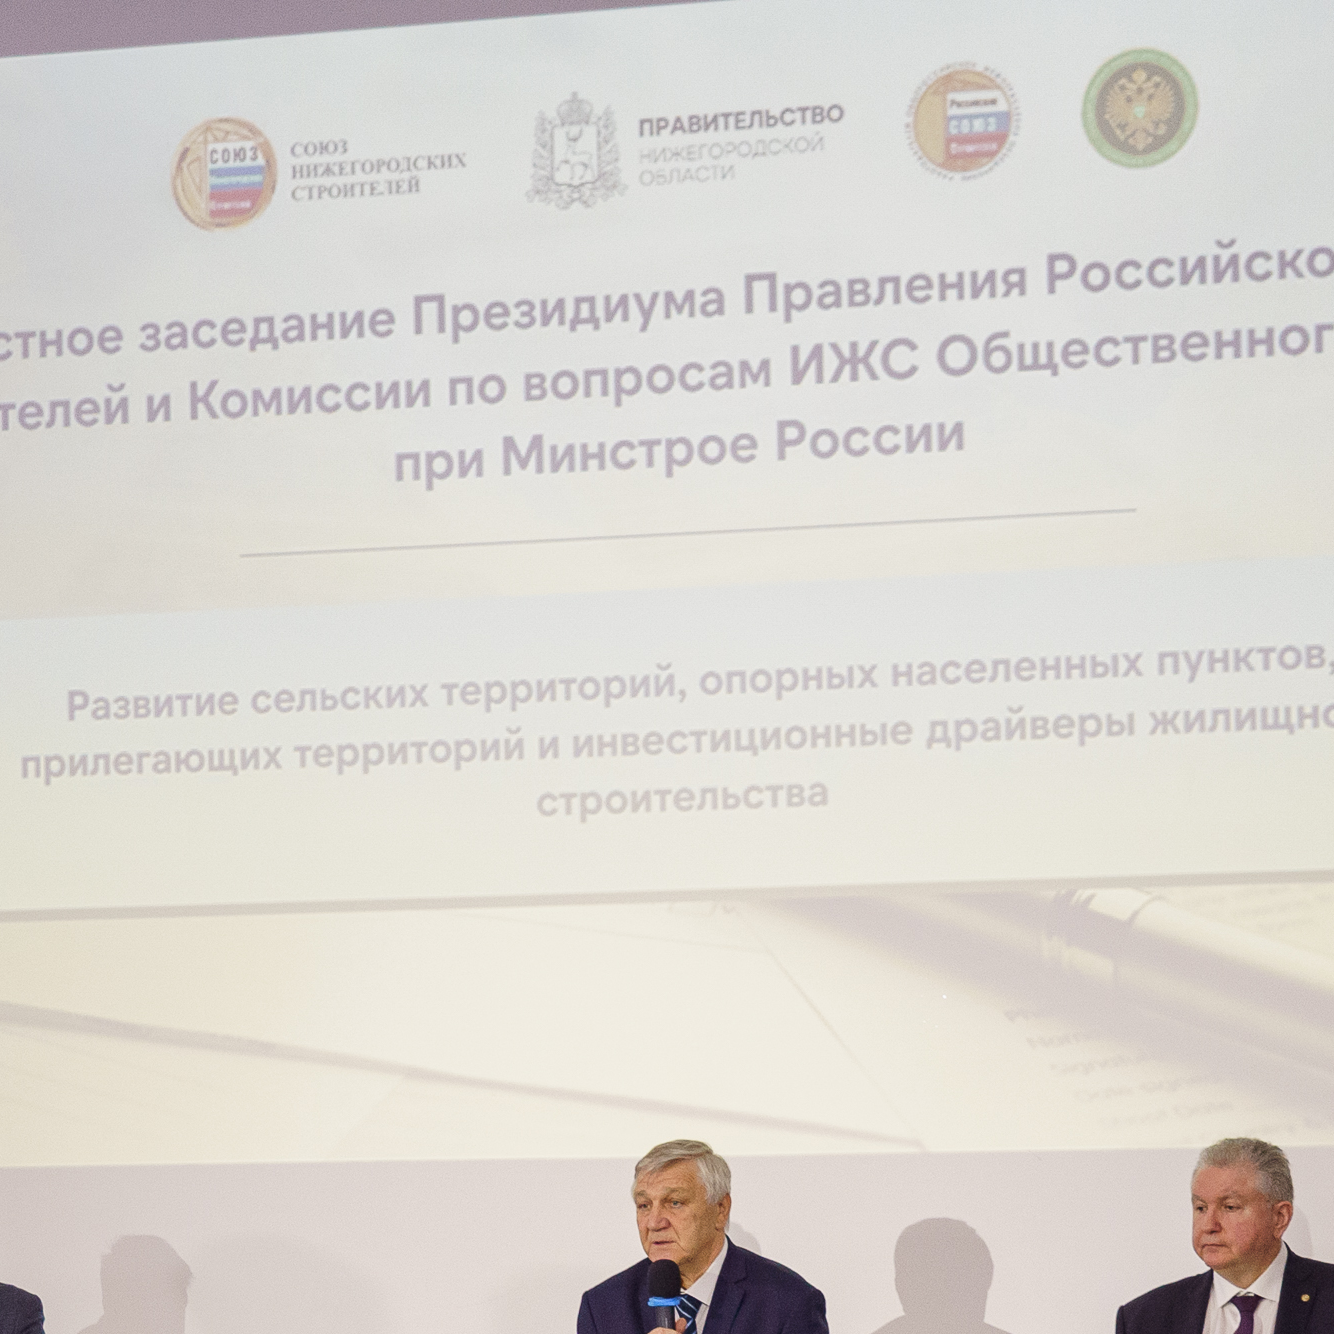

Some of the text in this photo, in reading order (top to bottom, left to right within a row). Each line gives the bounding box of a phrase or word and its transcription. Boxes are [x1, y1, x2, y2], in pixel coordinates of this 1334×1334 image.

[638, 103, 846, 138] ПРАВИТЕЛЬСТВО
[210, 146, 259, 164] СОЮЗ
[289, 138, 349, 158] СОЮЗ
[638, 131, 826, 165] НИЖЕГОРОДСКОЙ
[291, 153, 467, 180] НИЖЕГОРОДСКИХ
[637, 163, 736, 187] ОБЛАСТИ
[290, 174, 421, 202] СТРОИТЕЛЕЙ
[139, 307, 396, 353] заседание
[413, 286, 726, 345] Президиума
[743, 266, 1027, 324] Правления
[145, 393, 172, 424] и
[189, 378, 431, 421] Комиссии
[448, 373, 508, 406] по
[523, 357, 772, 408] вопросам
[790, 337, 919, 386] ИЖС
[394, 418, 965, 492] при Минстрое России
[66, 689, 240, 722] Развитие
[250, 683, 429, 715] сельских
[440, 662, 687, 714] территорий,
[698, 663, 878, 701] опорных
[891, 652, 1144, 688] населенных
[20, 746, 282, 787] прилегающих
[293, 726, 525, 776] территорий
[538, 735, 560, 760] и
[572, 719, 914, 759] инвестиционные
[925, 705, 1136, 752] драйверы
[536, 781, 830, 824] строительства
